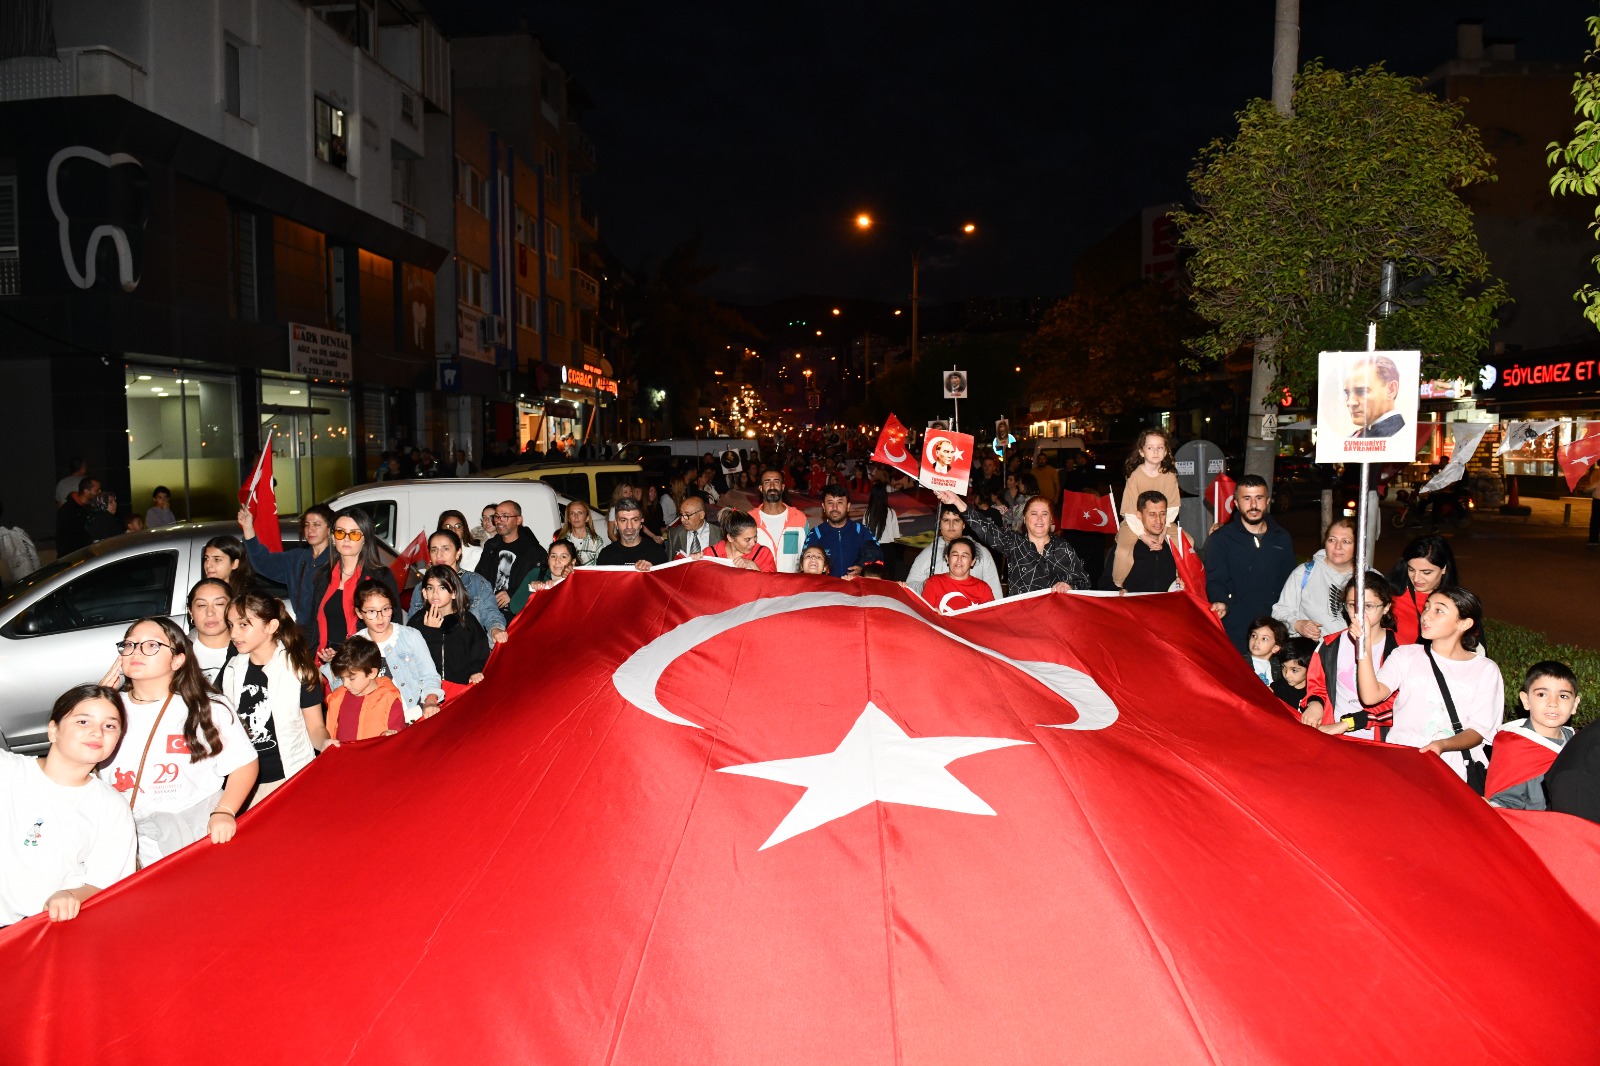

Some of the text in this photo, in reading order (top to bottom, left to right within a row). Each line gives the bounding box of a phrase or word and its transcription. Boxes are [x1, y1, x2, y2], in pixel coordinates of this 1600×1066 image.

[321, 335, 350, 350] DENTAL
[1503, 363, 1571, 387] SÖYLEMEZ
[1575, 360, 1595, 381] ET
[153, 762, 179, 784] 29
